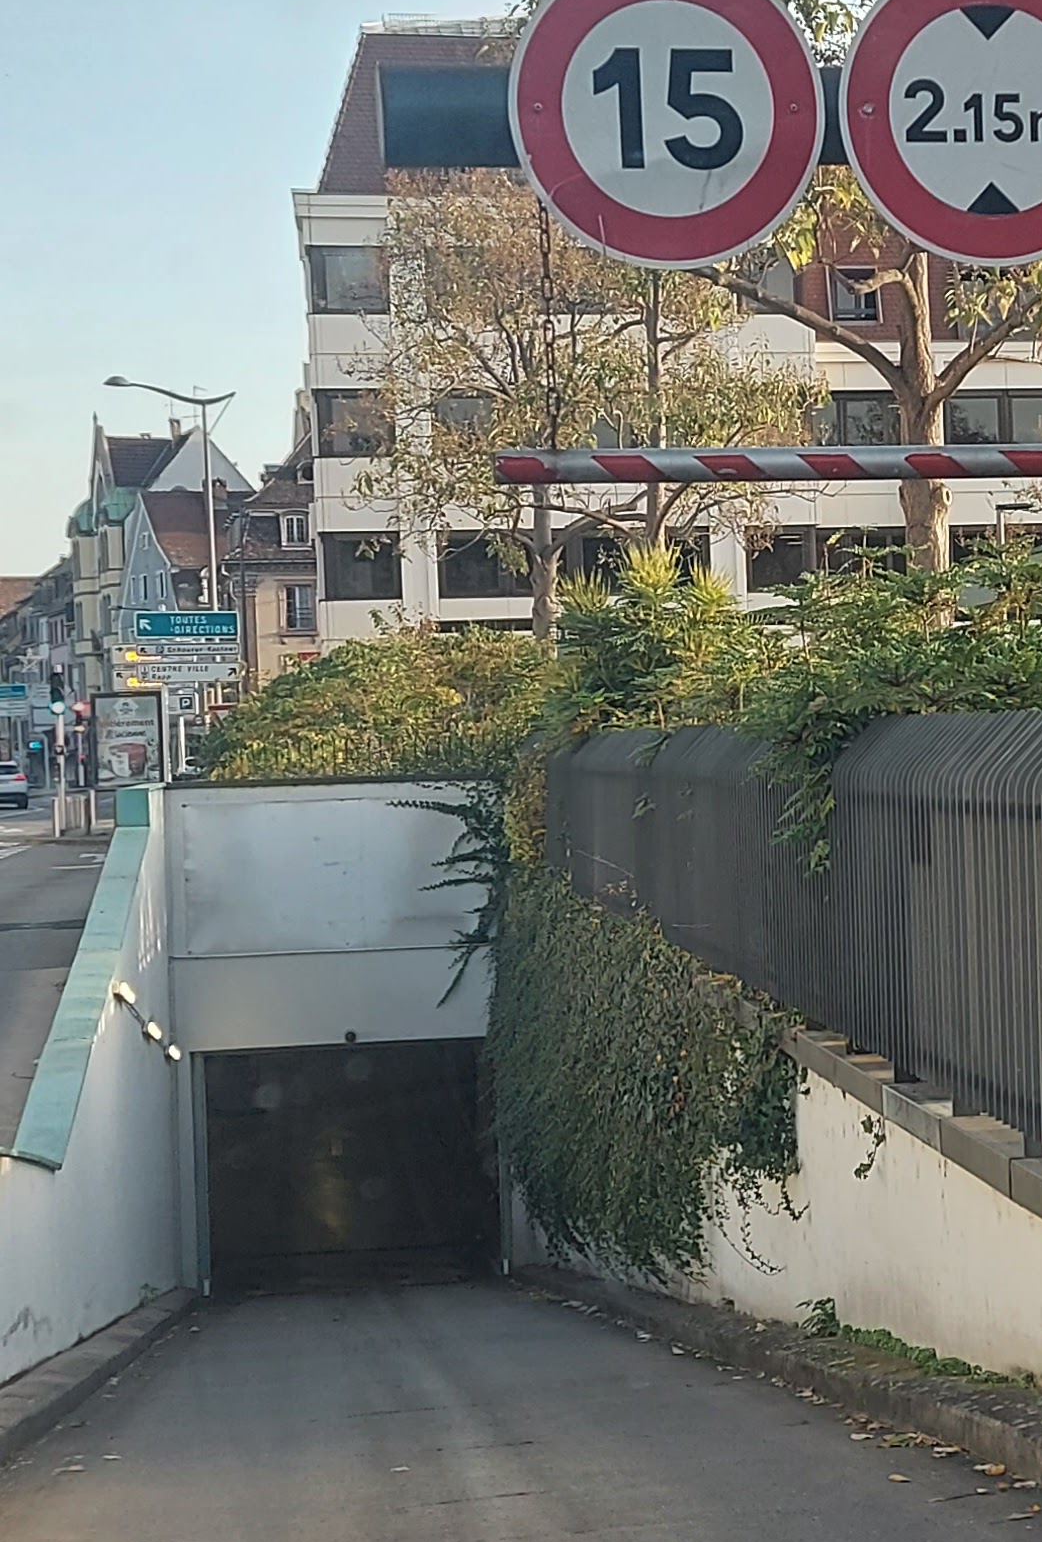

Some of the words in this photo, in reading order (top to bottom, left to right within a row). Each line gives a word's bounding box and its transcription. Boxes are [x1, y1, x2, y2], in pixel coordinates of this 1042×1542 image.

[592, 47, 744, 171] 15
[169, 615, 207, 625] TOUTES
[173, 625, 235, 634] DIRECTIONS
[151, 665, 182, 673] CENTRE
